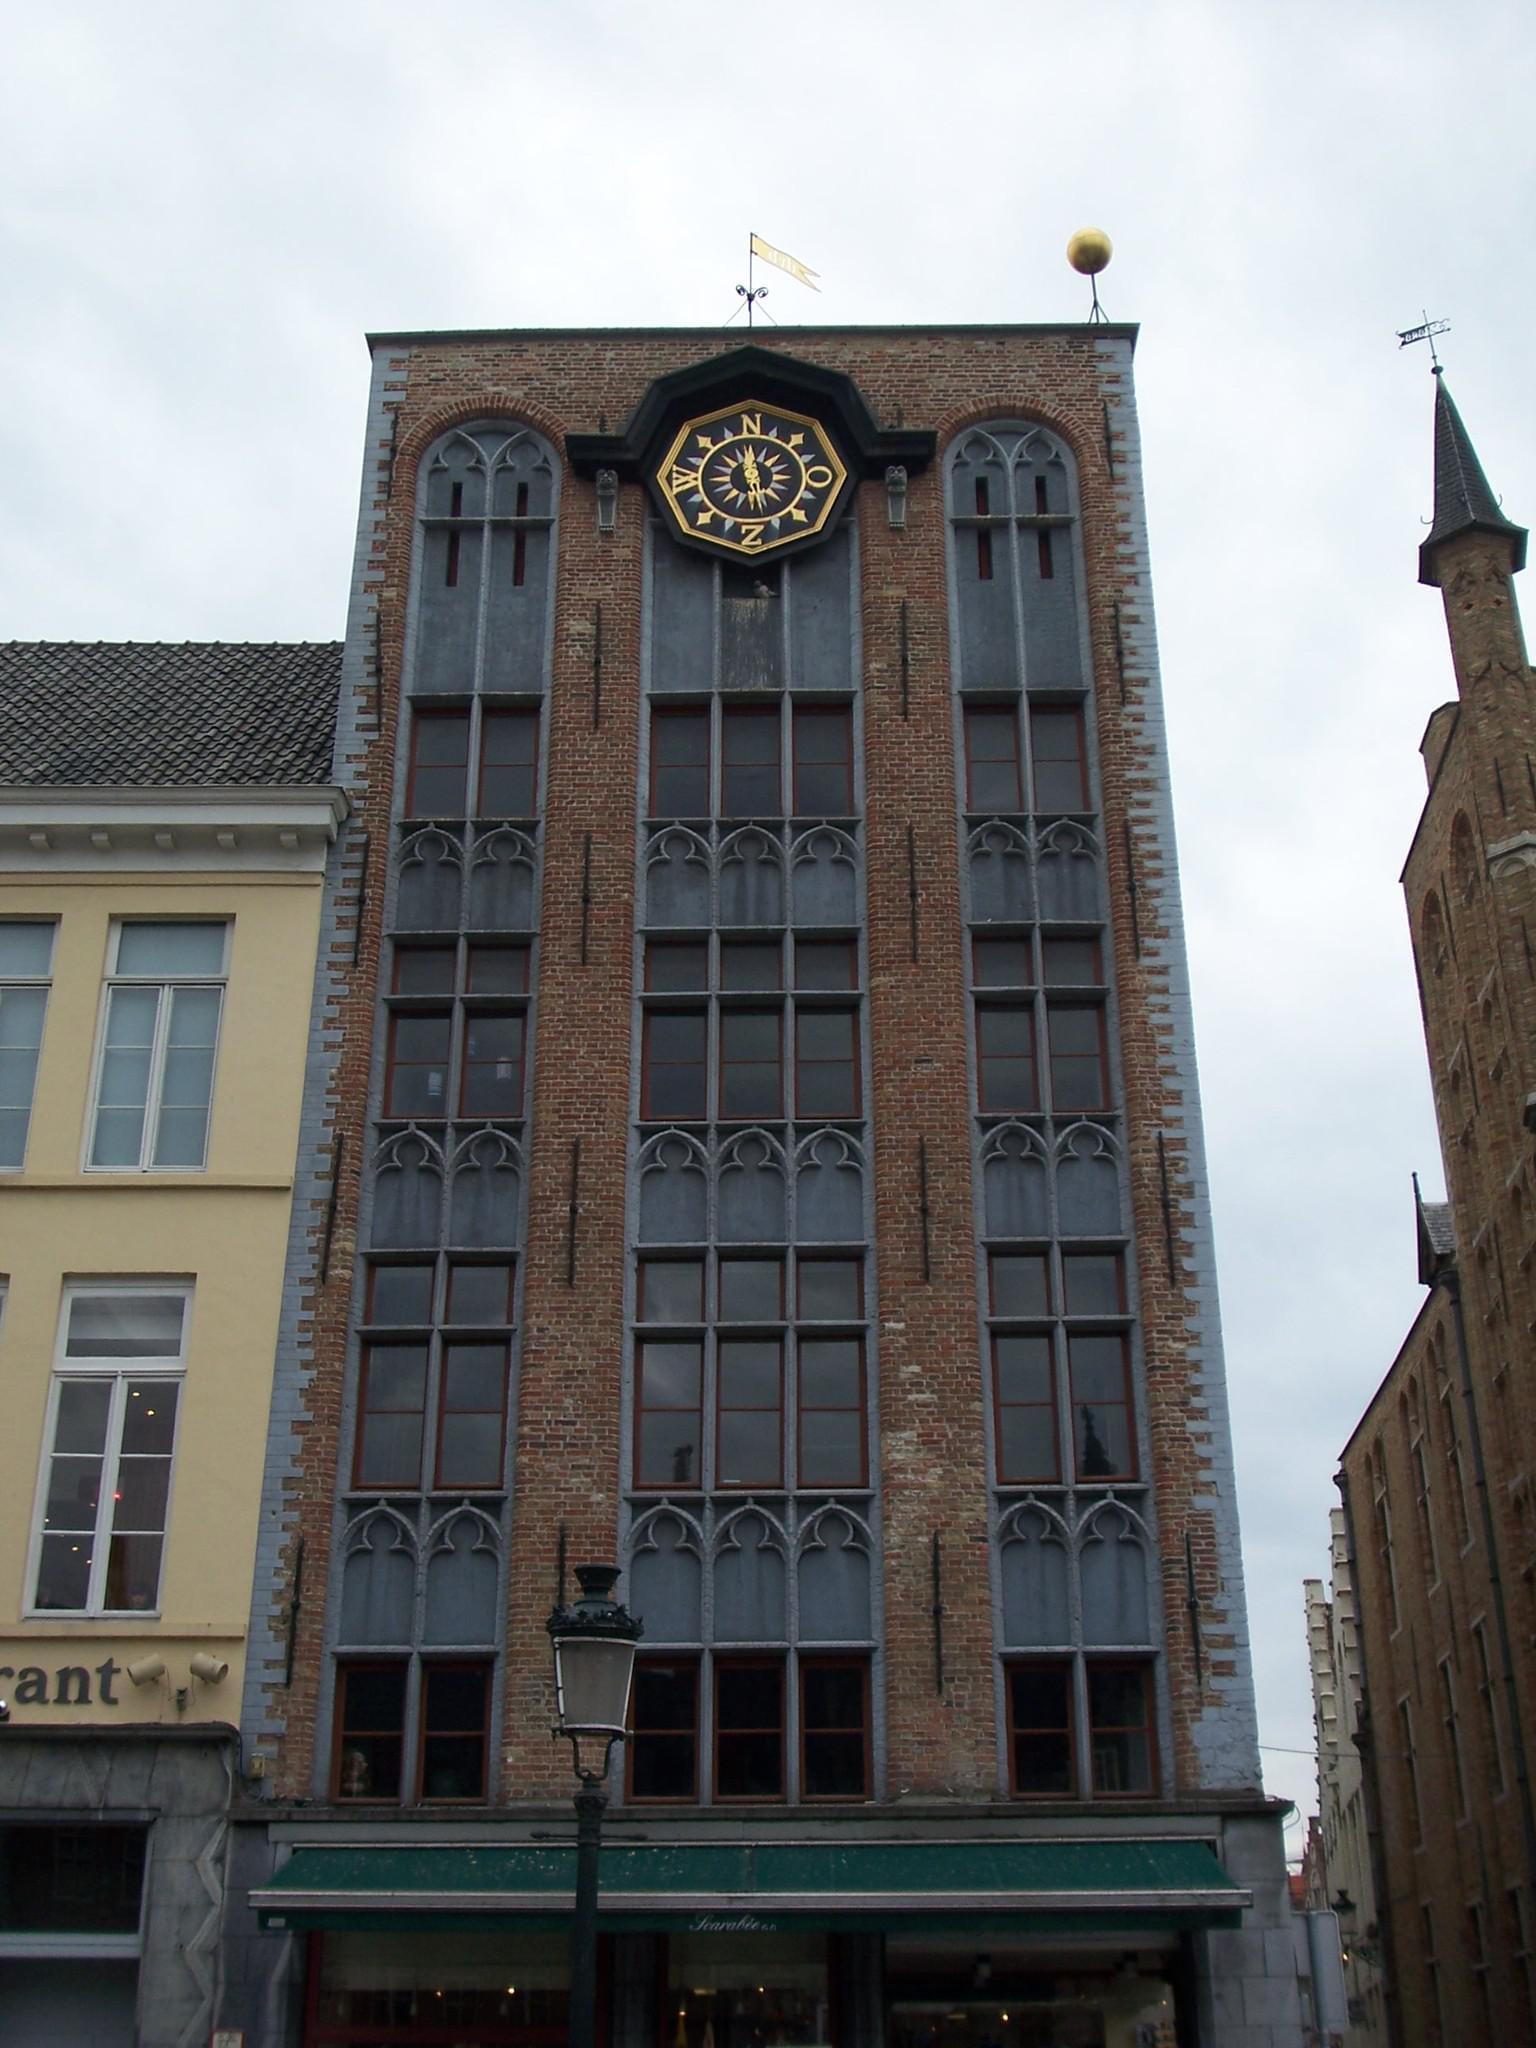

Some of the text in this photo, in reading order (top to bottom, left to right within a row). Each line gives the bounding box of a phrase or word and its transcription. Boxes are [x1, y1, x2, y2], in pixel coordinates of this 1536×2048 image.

[741, 413, 762, 435] N
[672, 464, 700, 495] W
[806, 465, 832, 488] O
[741, 524, 764, 546] Z
